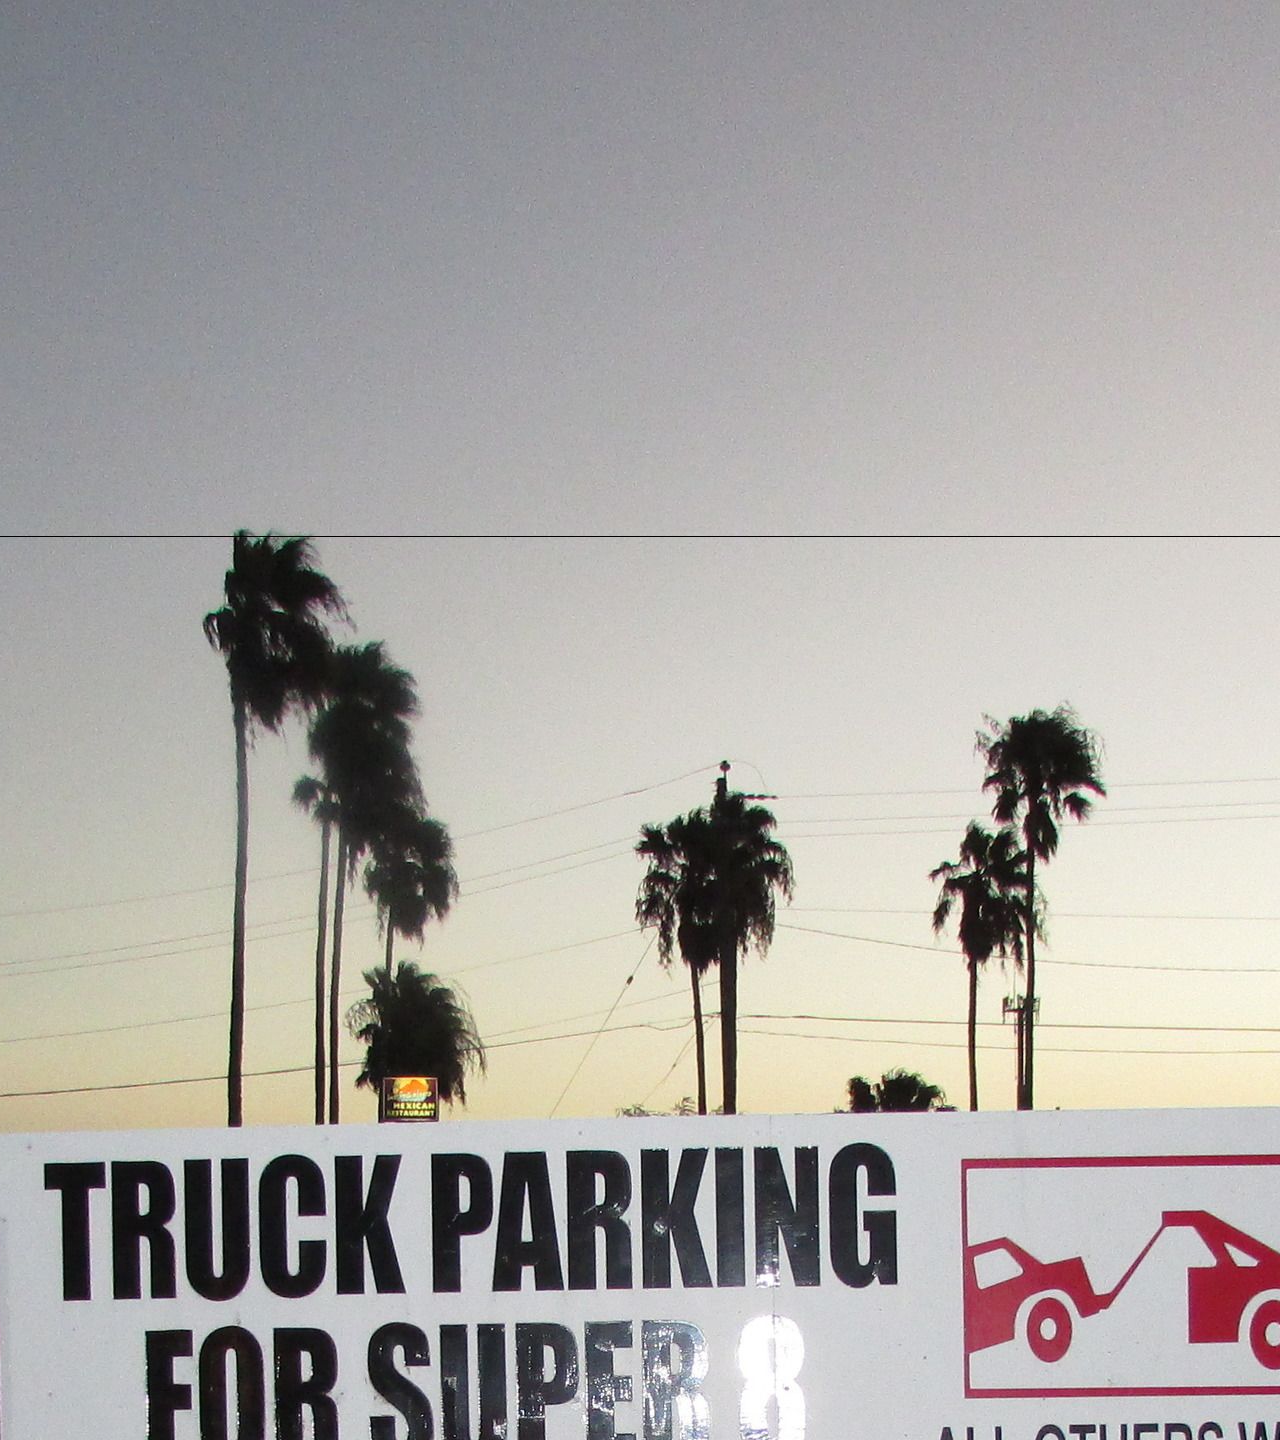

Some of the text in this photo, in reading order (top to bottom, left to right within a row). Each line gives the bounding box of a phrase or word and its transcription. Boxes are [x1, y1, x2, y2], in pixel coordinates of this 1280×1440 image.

[393, 1102, 435, 1110] MEXICAN
[44, 1142, 898, 1301] TRUCK PARKING
